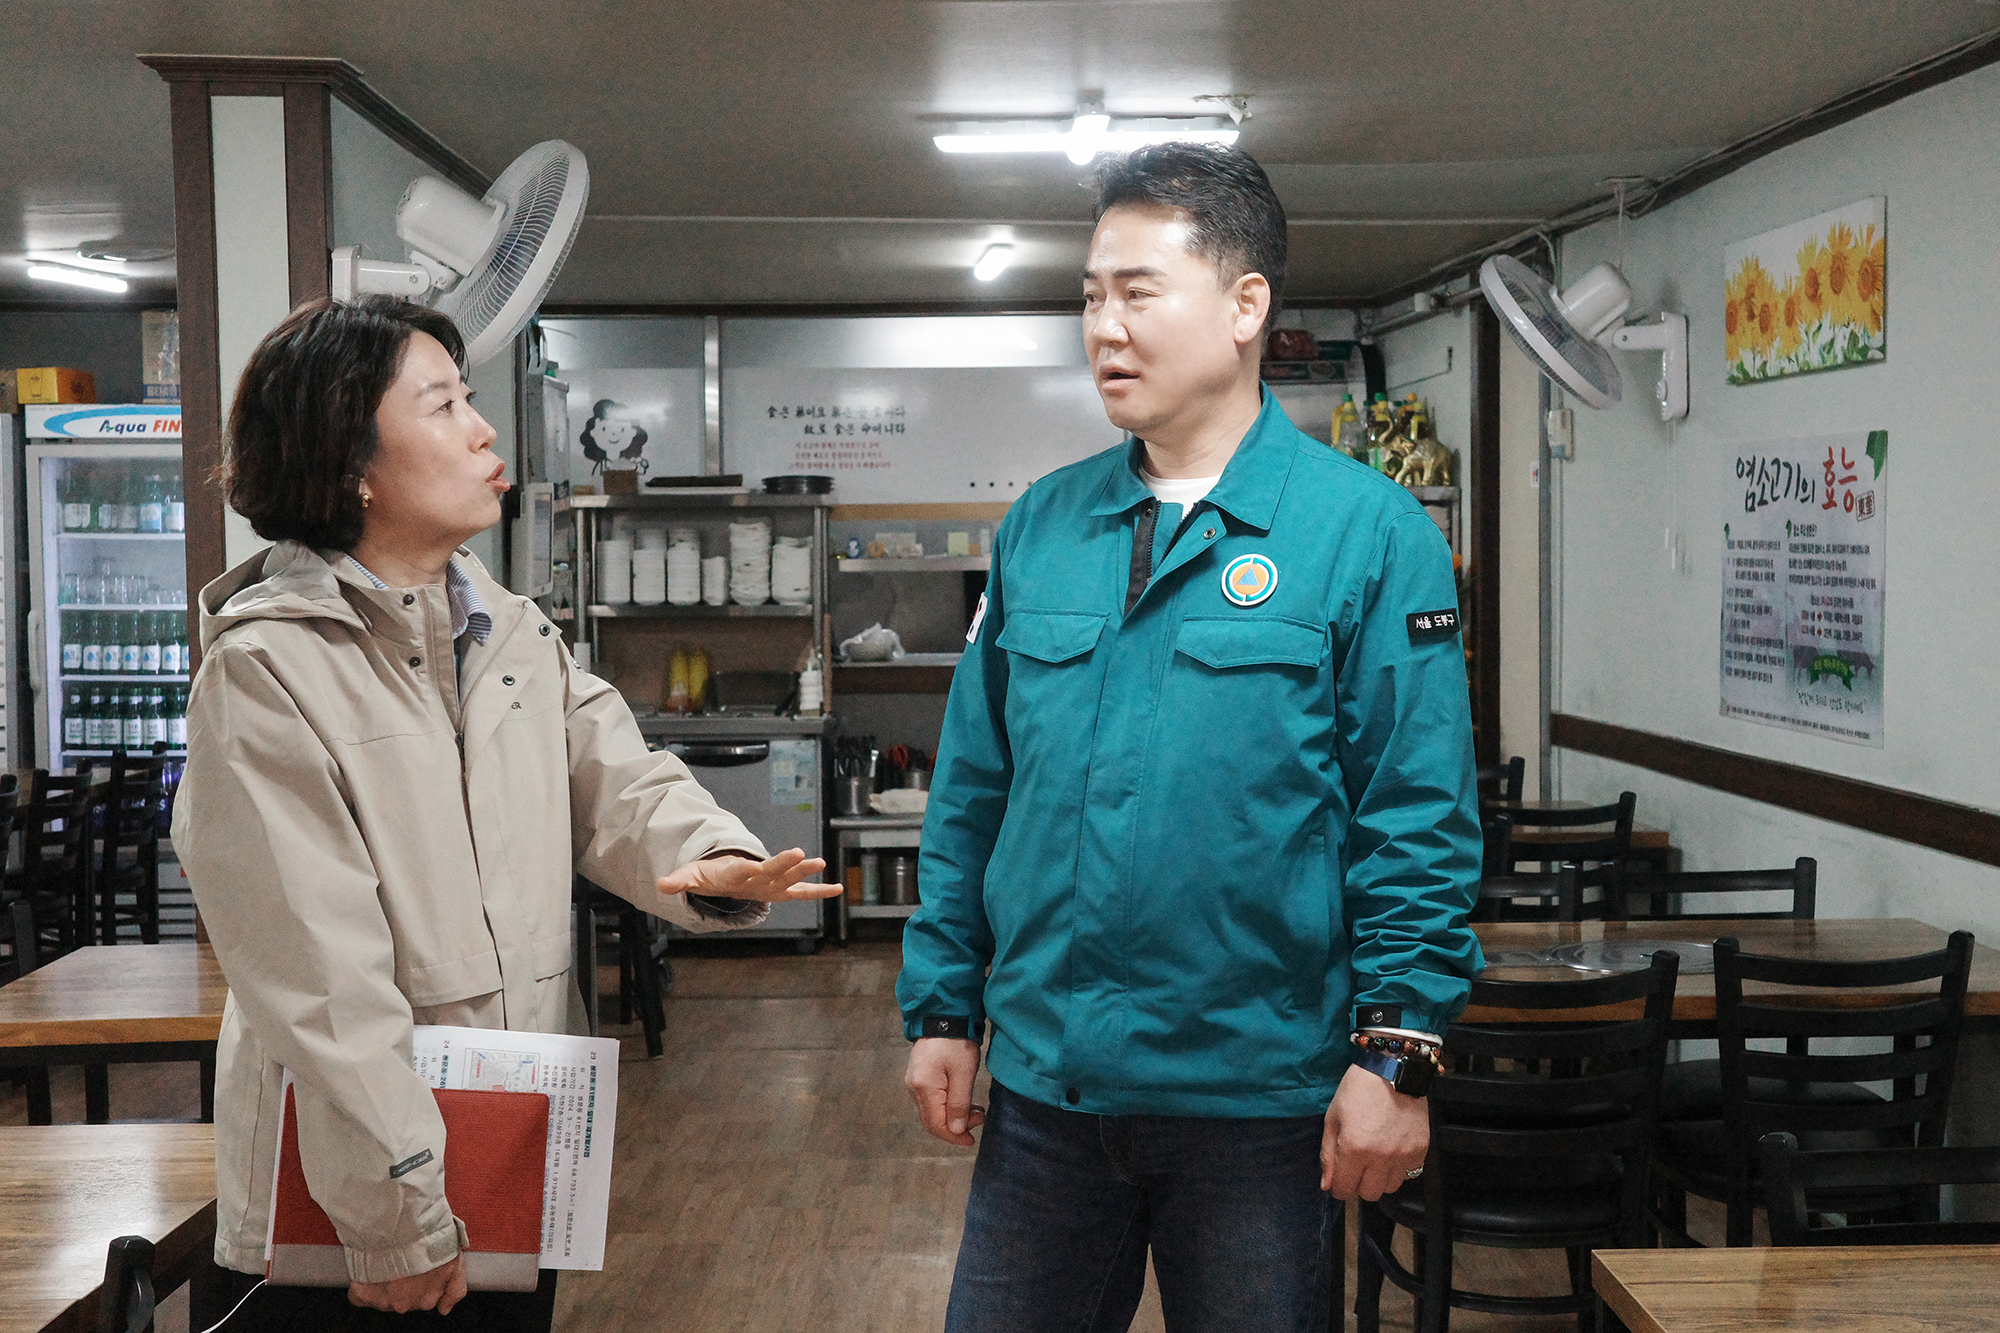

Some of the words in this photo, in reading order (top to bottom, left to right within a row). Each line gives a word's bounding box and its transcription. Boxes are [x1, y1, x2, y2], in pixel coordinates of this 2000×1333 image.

[98, 419, 147, 435] Aqua
[152, 419, 182, 433] FIN
[1735, 453, 1816, 514] 염소고기의
[1821, 445, 1859, 514] 효능
[1416, 616, 1432, 629] 서울
[1434, 614, 1455, 627] 도봉구
[420, 1055, 428, 1078] 사업기
